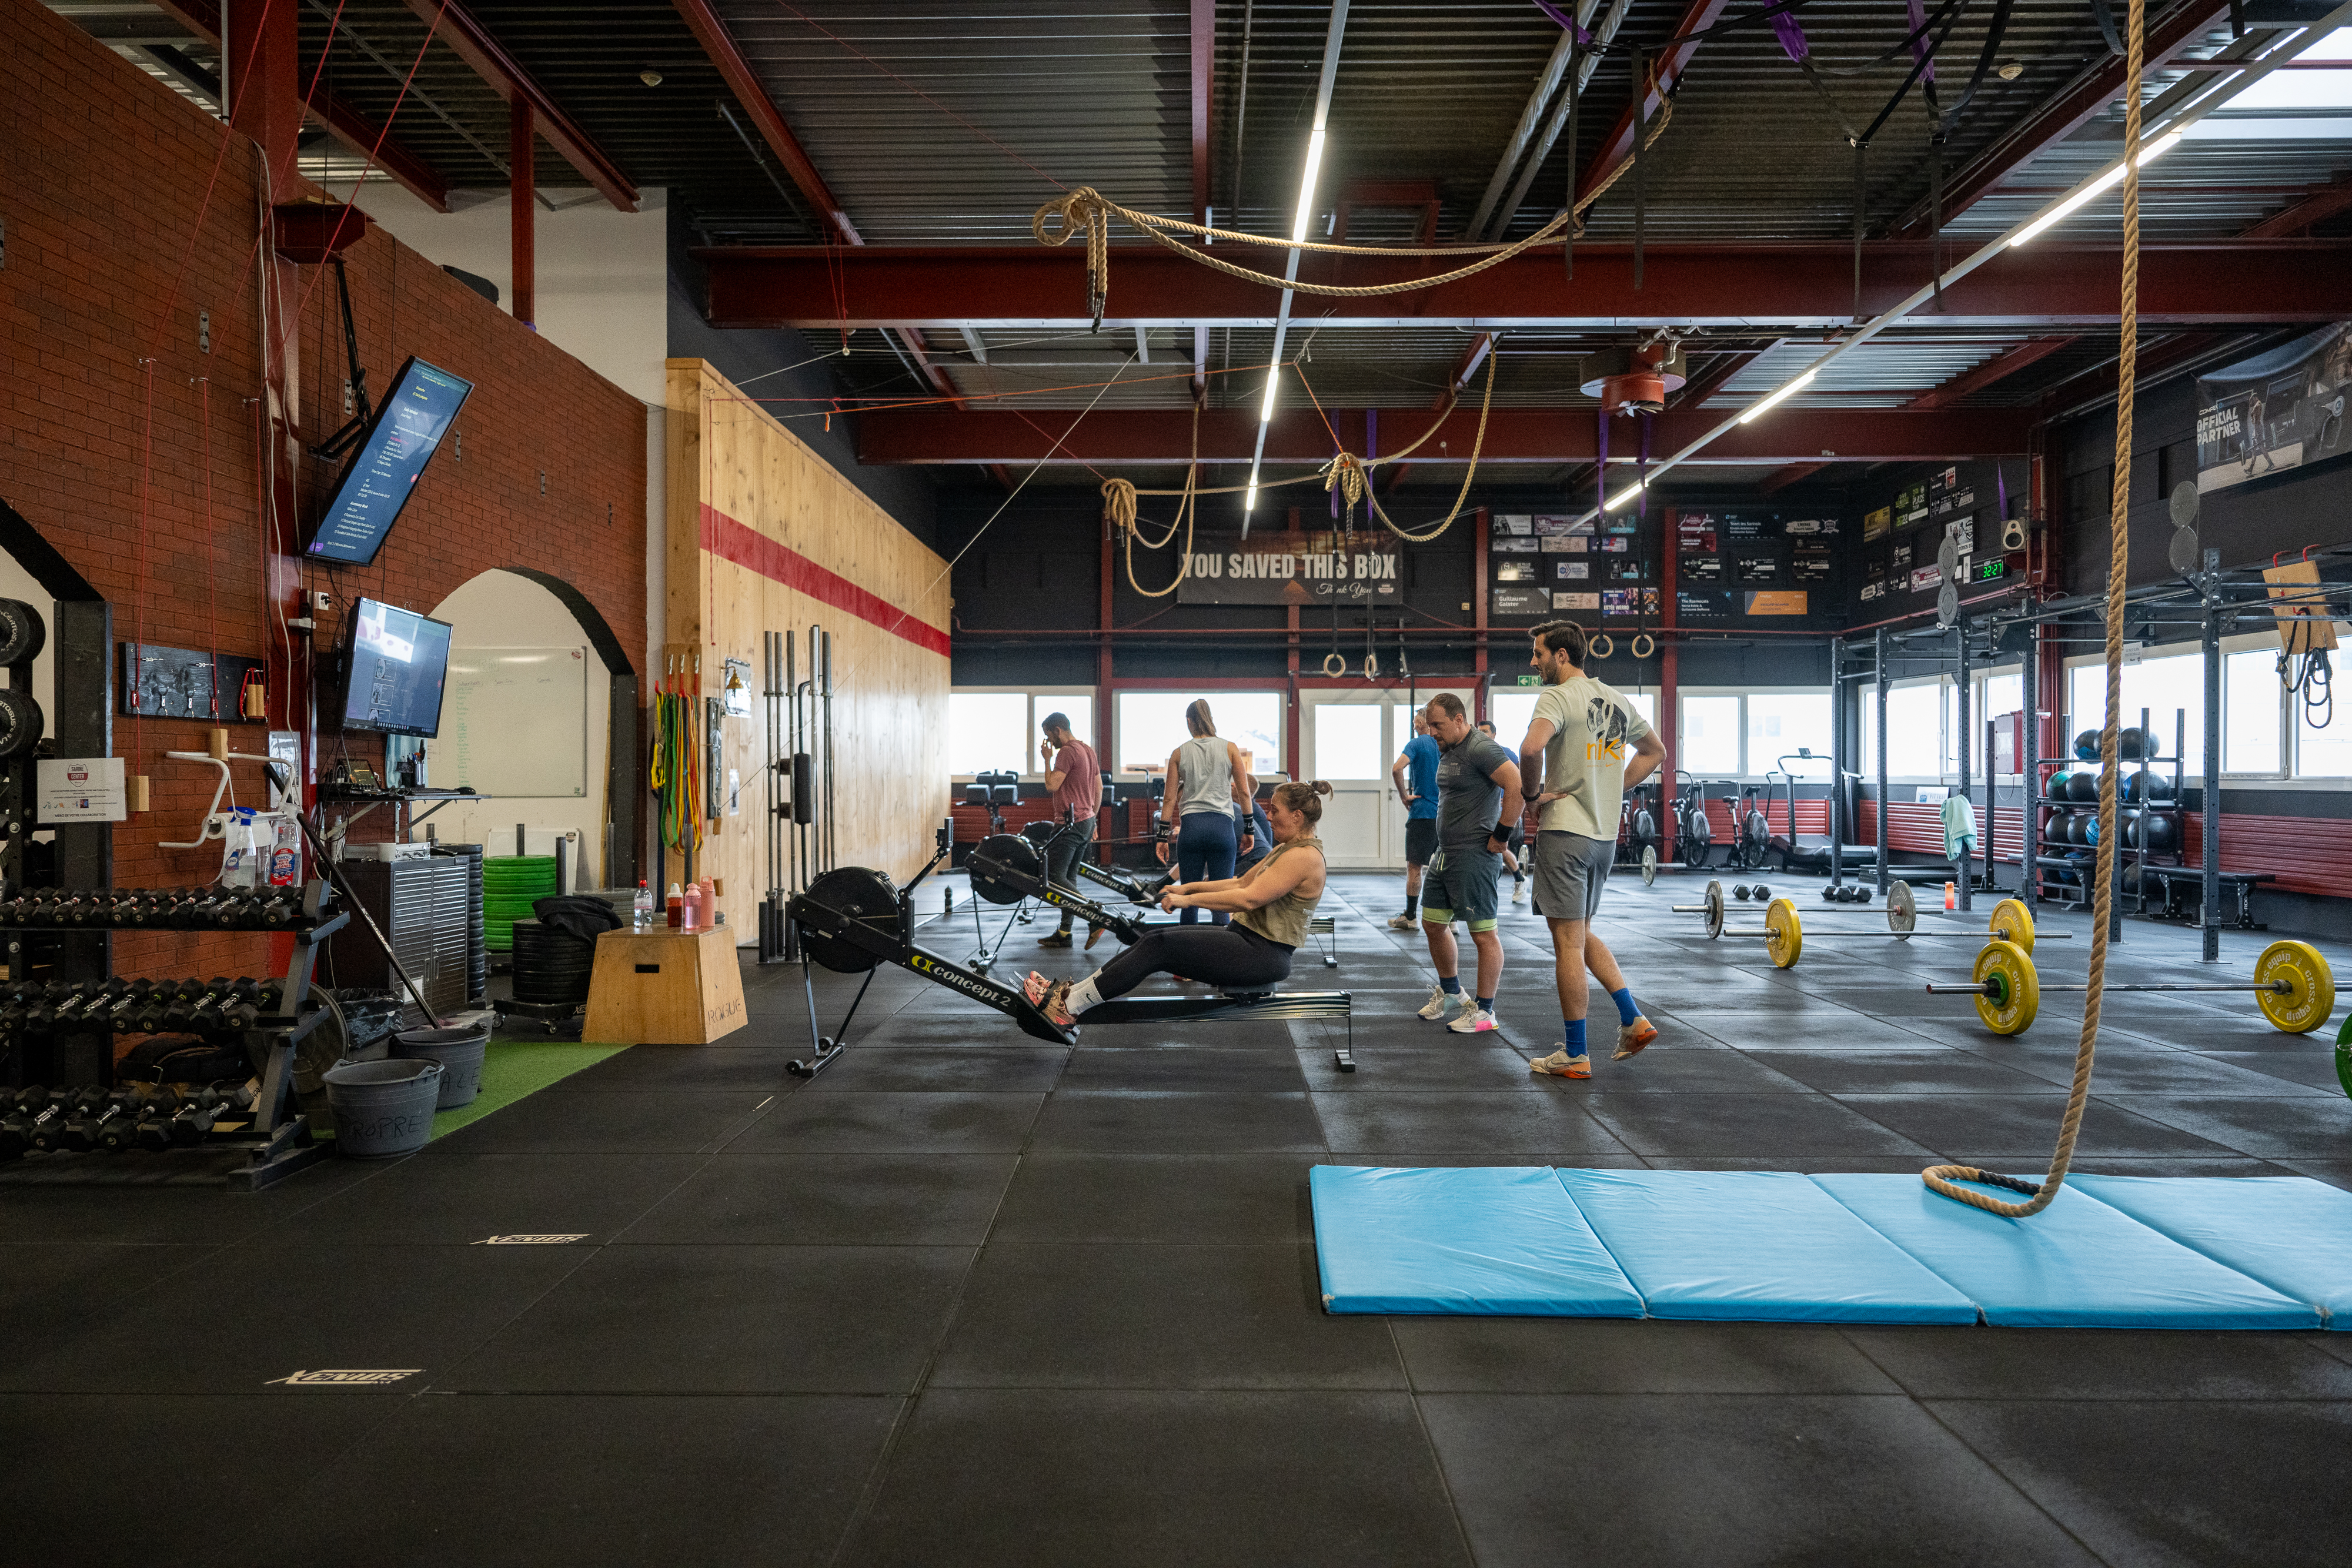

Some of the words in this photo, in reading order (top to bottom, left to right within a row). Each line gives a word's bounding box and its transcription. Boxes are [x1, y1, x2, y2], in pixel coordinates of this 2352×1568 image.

[2197, 407, 2239, 433] OFFICIAL
[2199, 404, 2218, 415] COMPEX
[2197, 420, 2241, 446] PARTNER
[1182, 554, 1222, 579] YOU
[1228, 554, 1295, 579] SAVED
[1302, 554, 1347, 579] THIS
[1354, 554, 1395, 579] BOX
[1983, 563, 2002, 577] 32:27
[1316, 583, 1347, 595] Thnk
[1086, 871, 1118, 888] concept
[1061, 900, 1104, 922] concept
[1983, 952, 2002, 971] equip
[2267, 951, 2291, 969] equip
[934, 967, 999, 1001] concept
[1000, 996, 1011, 1007] 2
[2305, 970, 2316, 1004] cross
[707, 999, 741, 1025] ROGUE
[2286, 1005, 2311, 1022] equip
[442, 1066, 480, 1092] ALE
[337, 1114, 422, 1138] PROPRE
[264, 1369, 425, 1385] XENIOS
